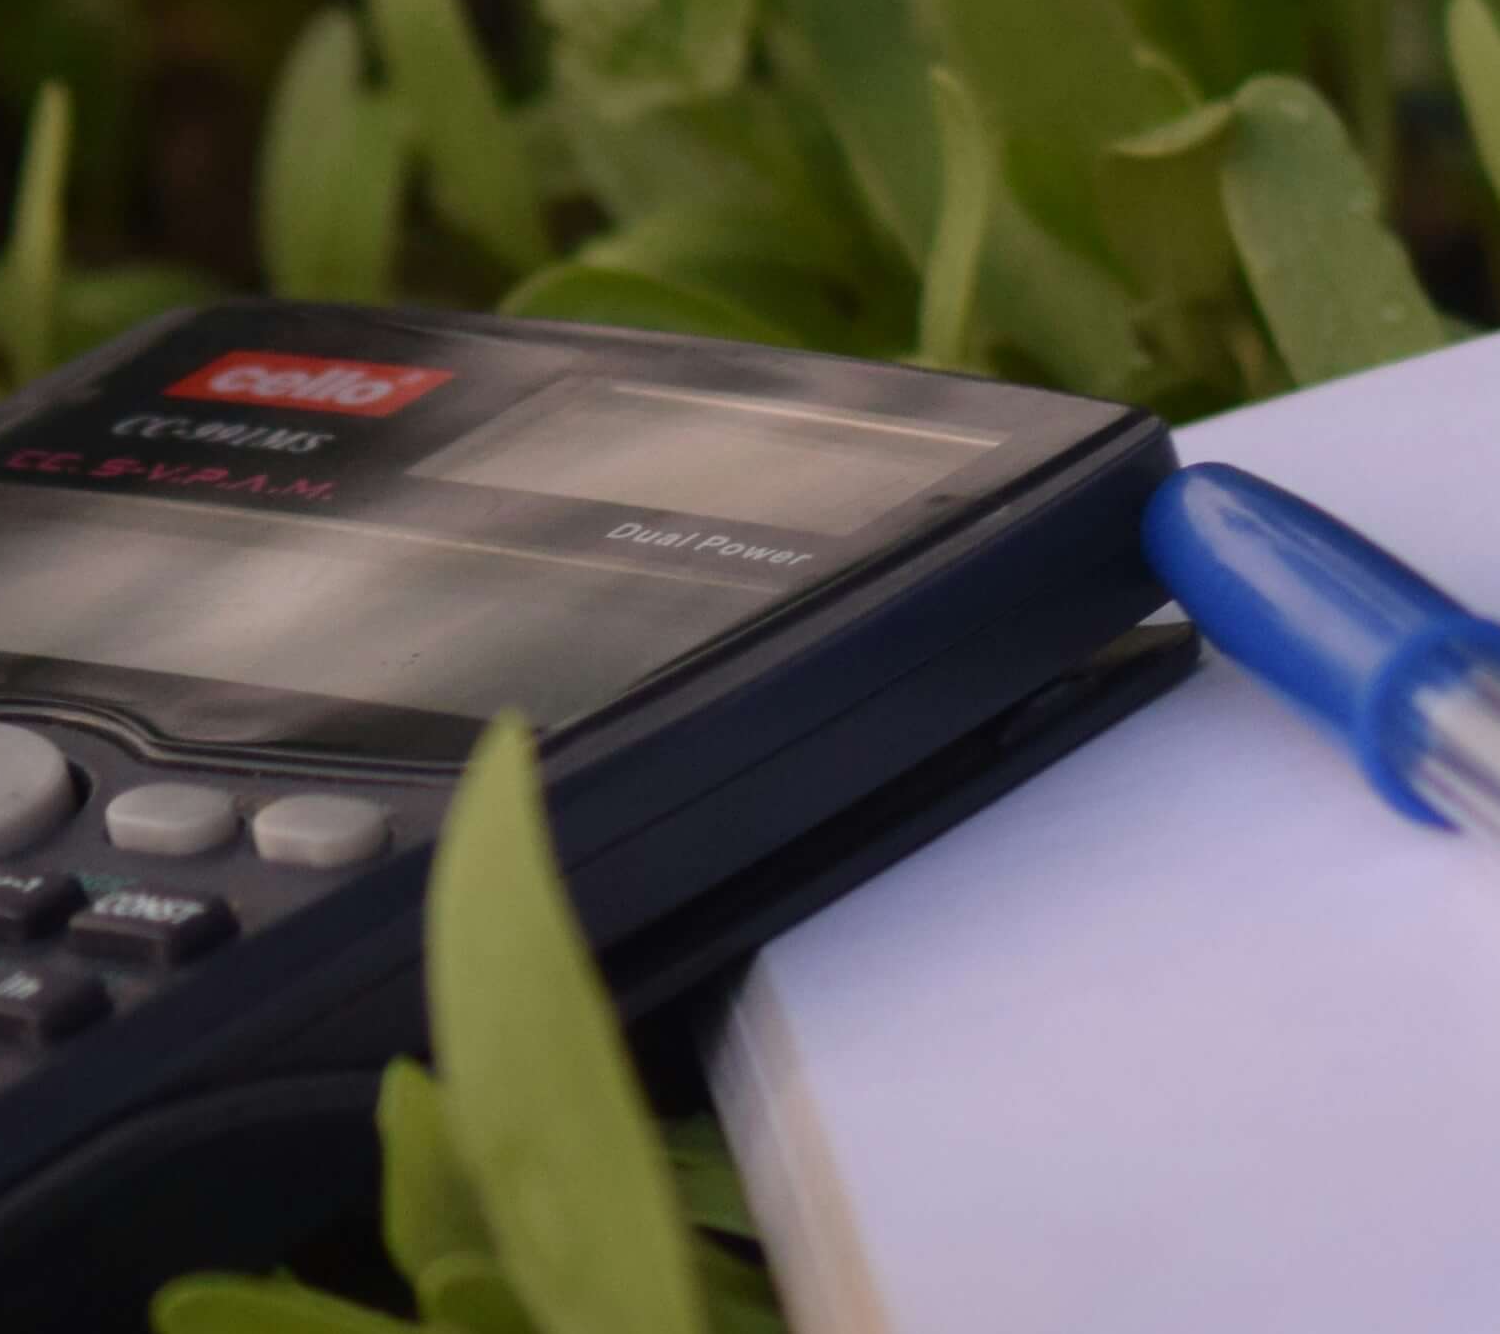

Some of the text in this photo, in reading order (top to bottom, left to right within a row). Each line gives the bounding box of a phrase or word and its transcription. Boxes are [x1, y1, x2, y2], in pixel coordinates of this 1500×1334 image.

[209, 364, 393, 405] cello
[606, 522, 812, 566] Dual Power
